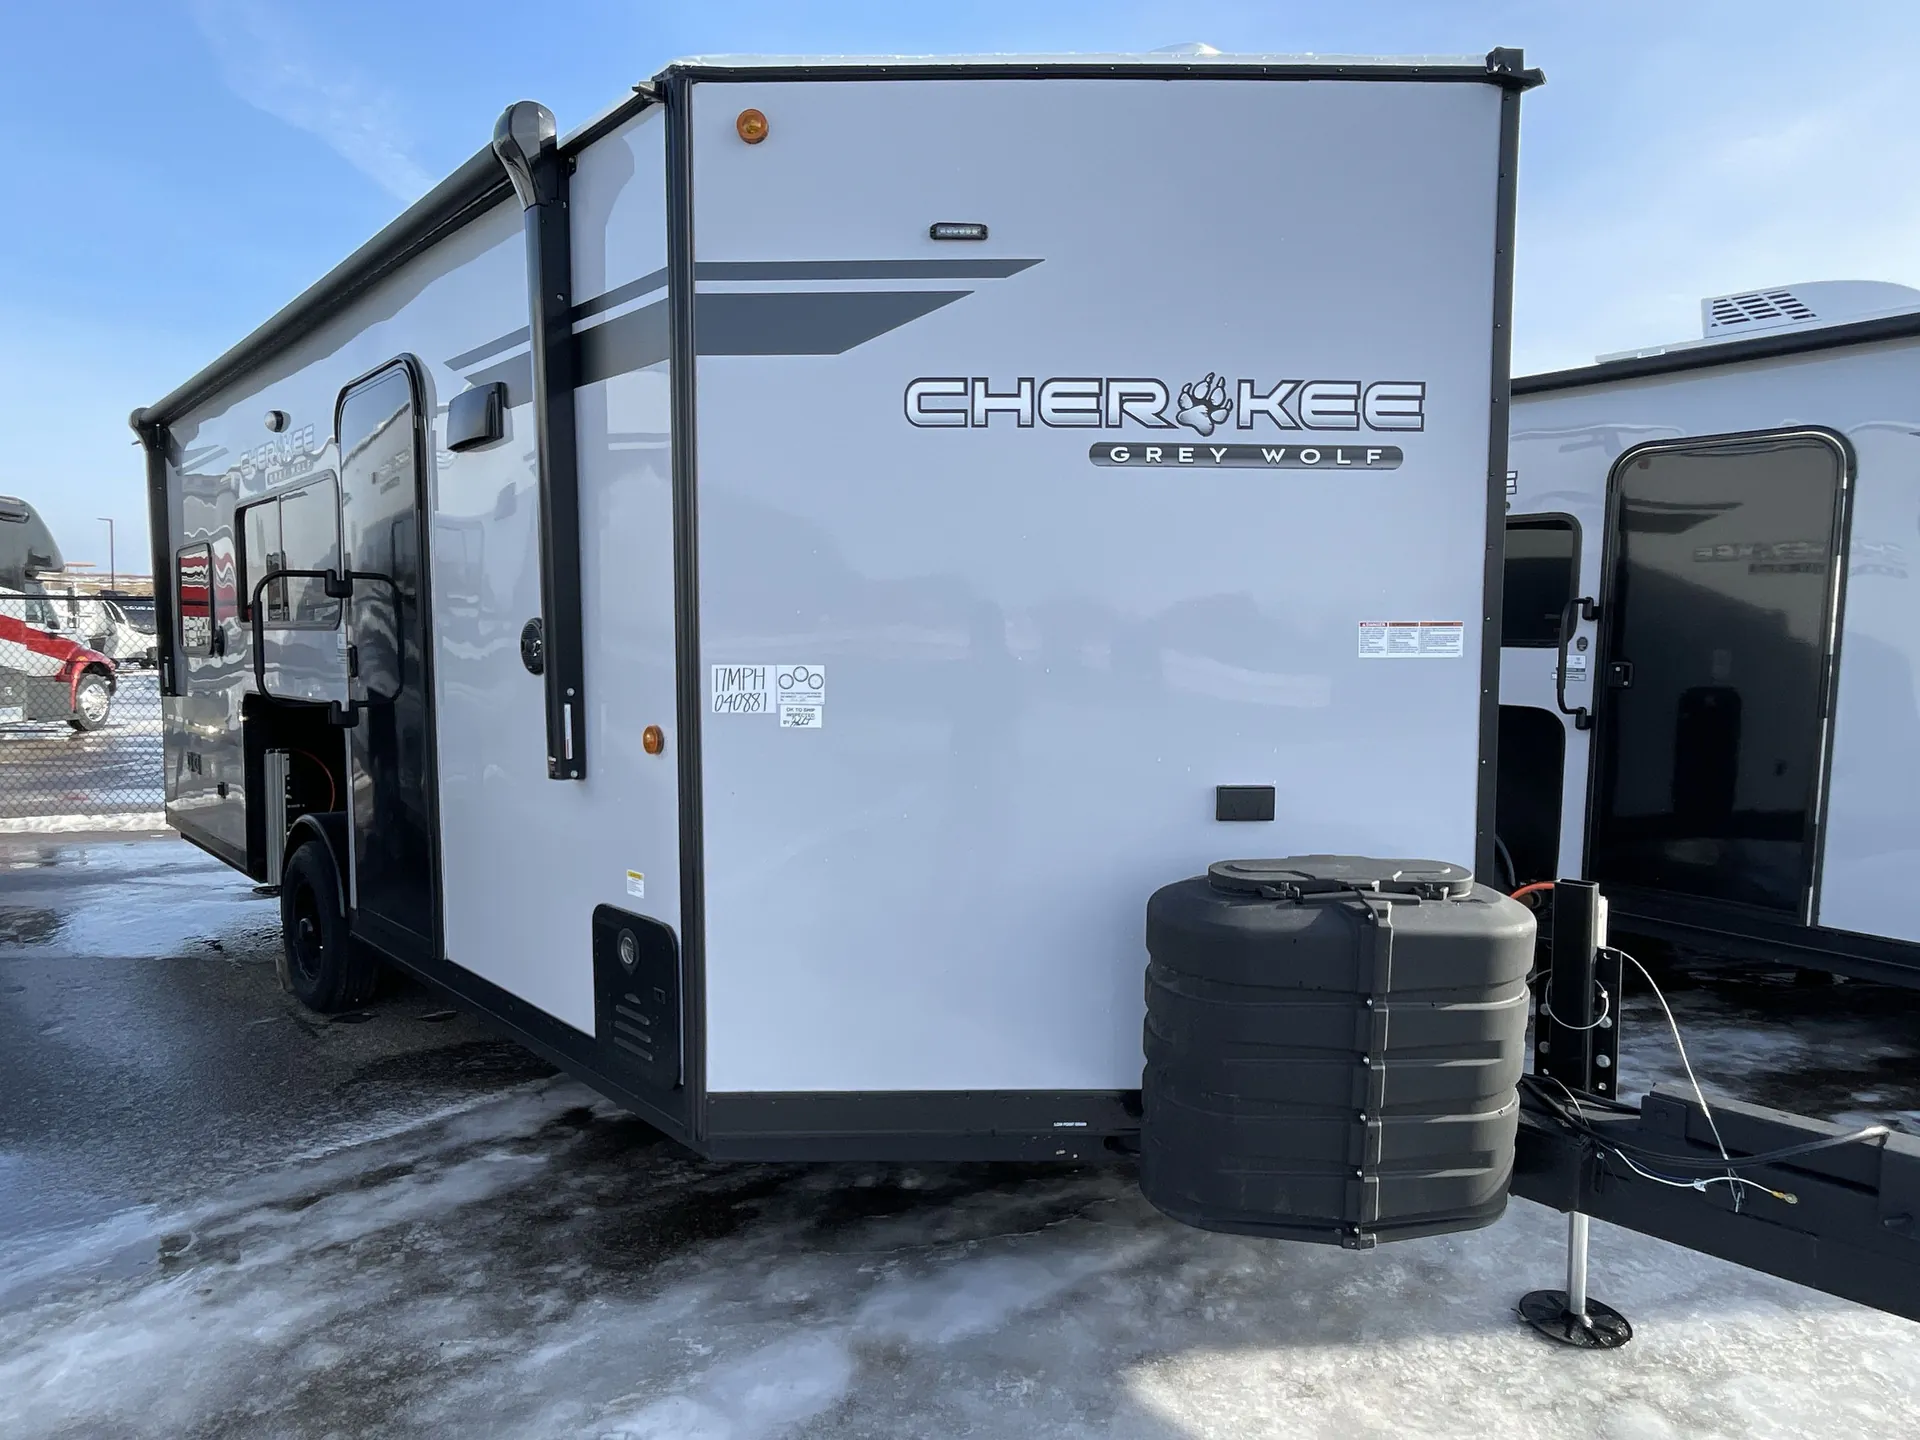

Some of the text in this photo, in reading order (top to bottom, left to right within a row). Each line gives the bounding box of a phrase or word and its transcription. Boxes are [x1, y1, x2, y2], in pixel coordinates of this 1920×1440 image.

[1110, 446, 1382, 465] GREY WOLF
[714, 692, 767, 713] 040881
